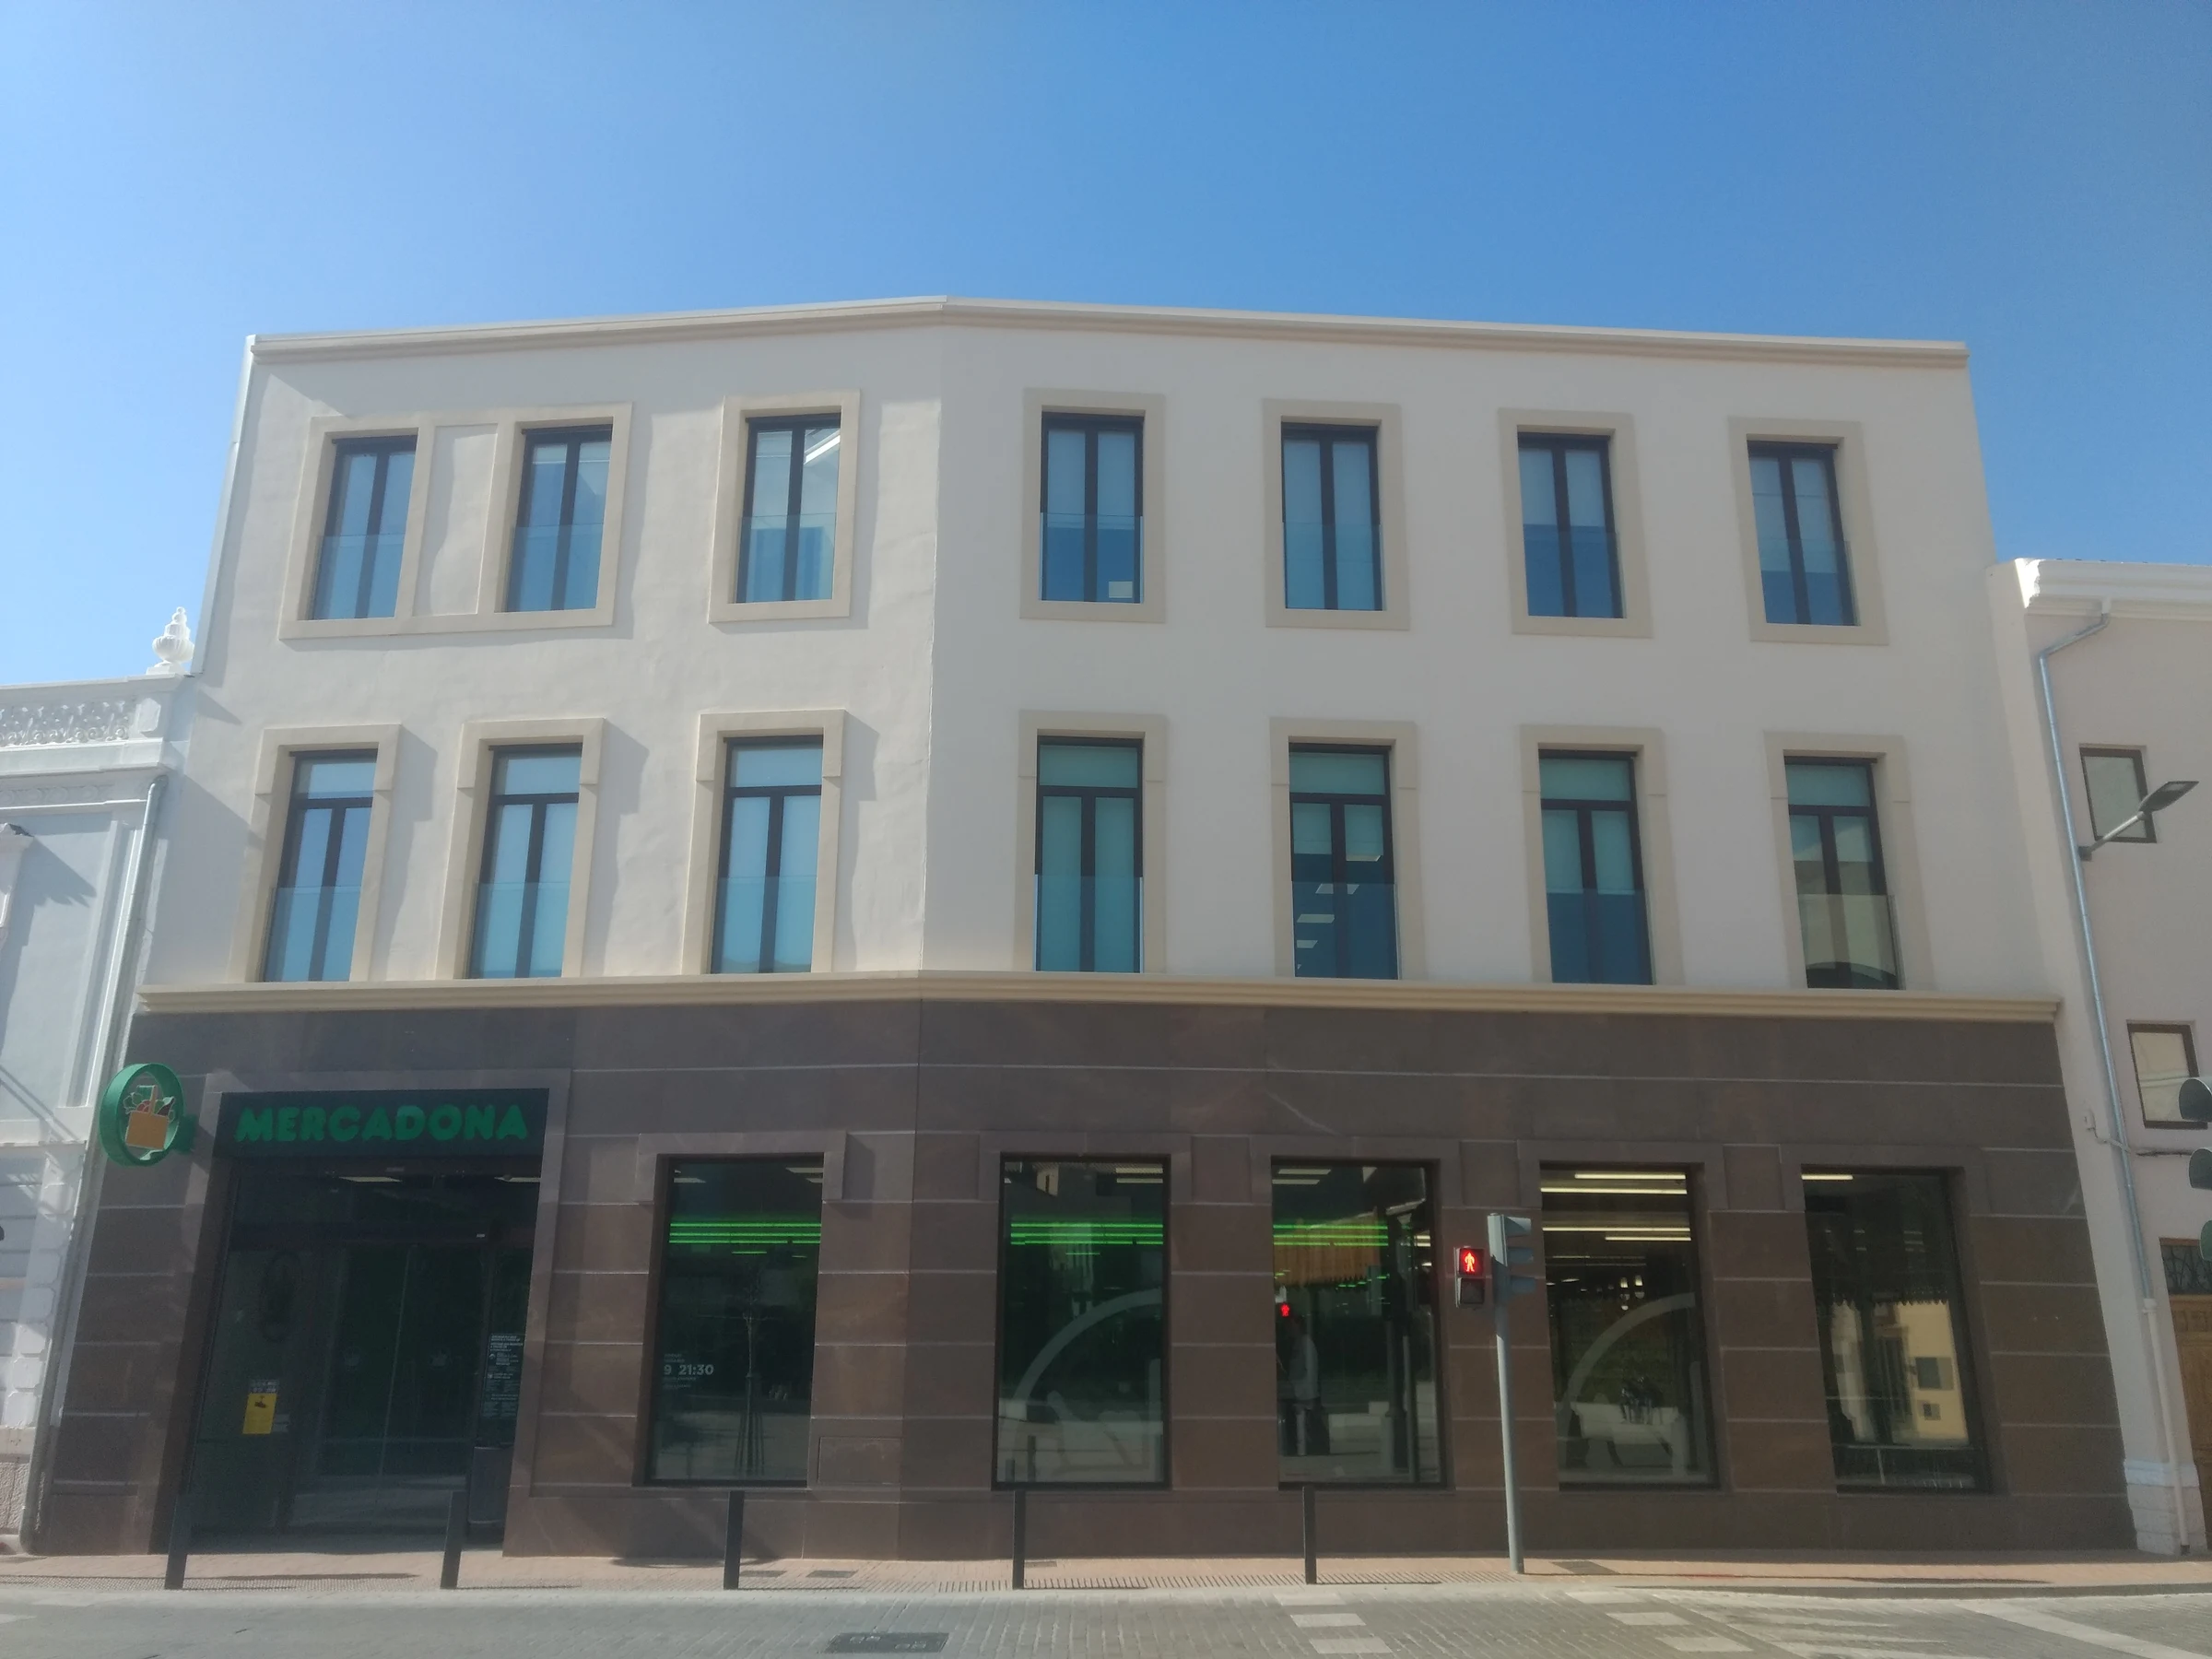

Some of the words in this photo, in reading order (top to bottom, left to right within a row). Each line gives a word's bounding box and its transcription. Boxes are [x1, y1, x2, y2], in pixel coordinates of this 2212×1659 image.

[234, 1104, 528, 1142] MERCADONA
[664, 1364, 672, 1375] 9
[678, 1364, 714, 1375] 21:30
